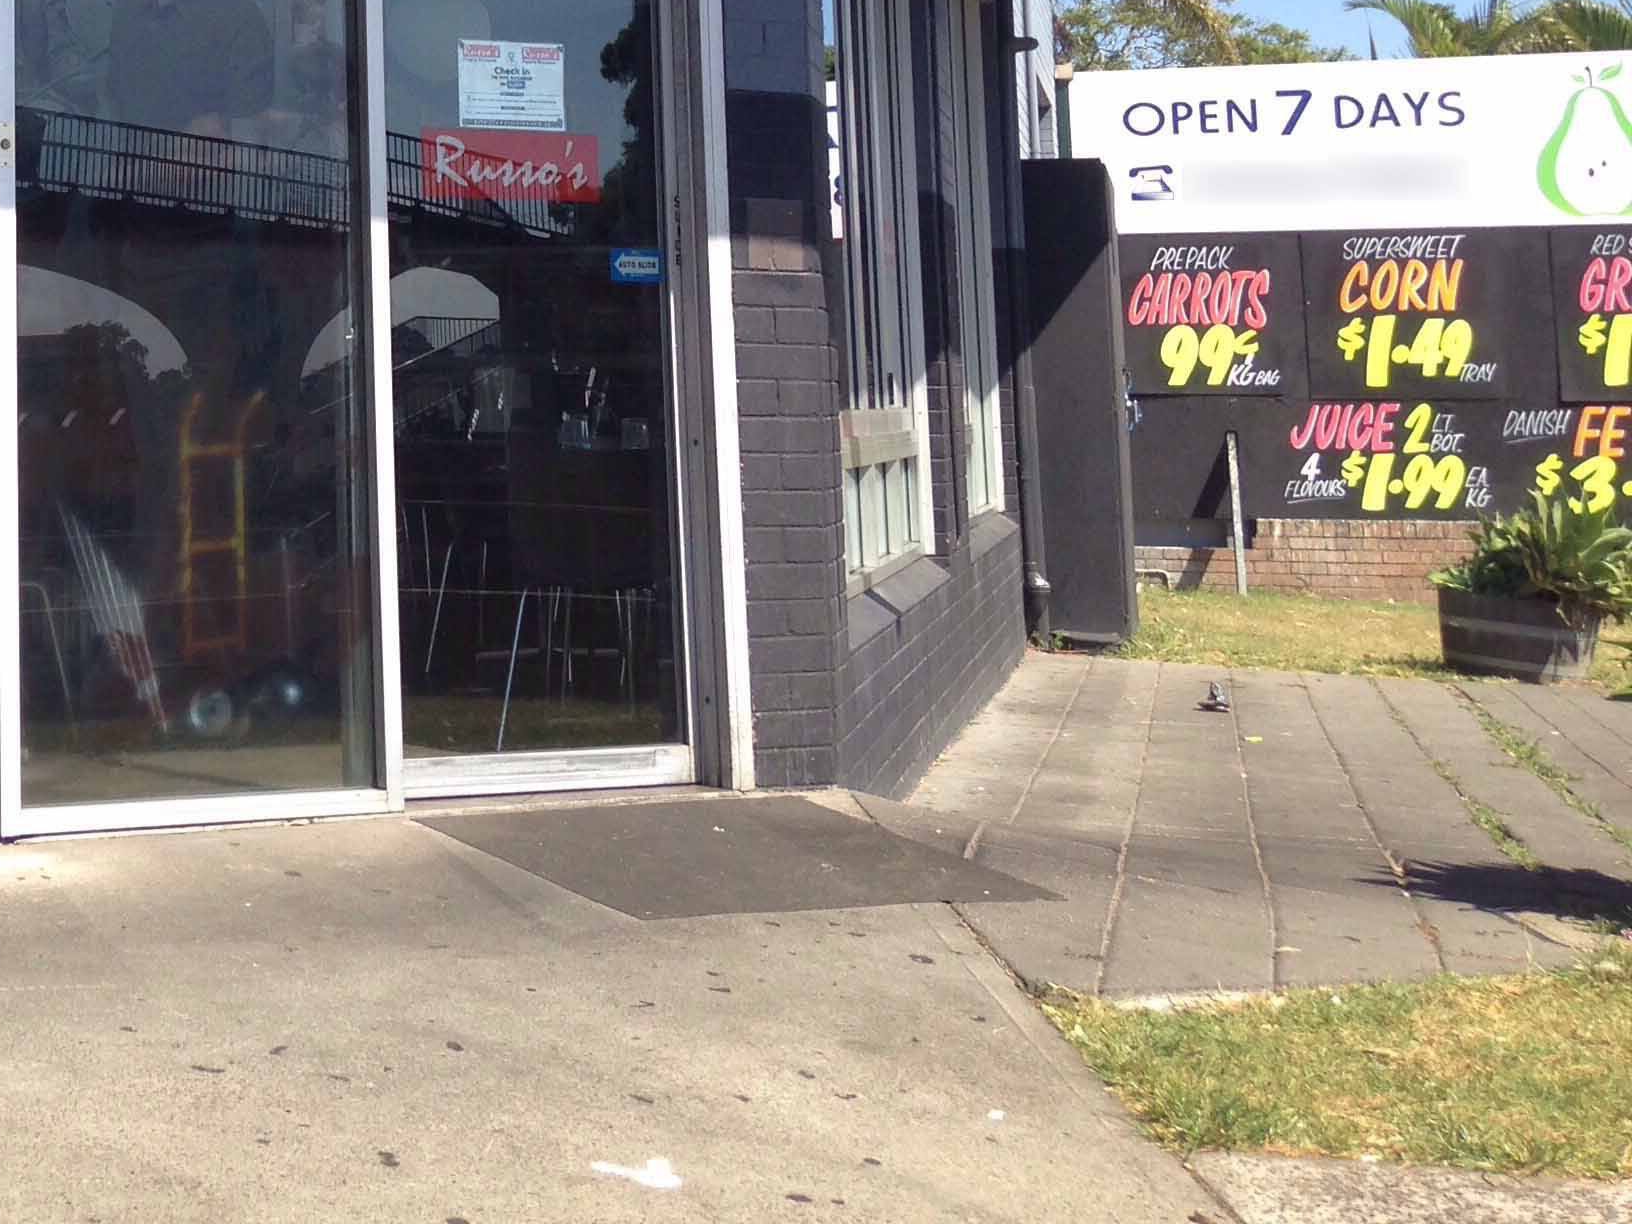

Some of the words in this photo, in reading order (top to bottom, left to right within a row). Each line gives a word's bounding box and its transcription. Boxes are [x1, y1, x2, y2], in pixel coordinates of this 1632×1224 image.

[1122, 98, 1258, 137] OPEN
[1275, 89, 1312, 136] 7
[1334, 91, 1466, 129] DAYS
[434, 135, 588, 190] Russo's
[1150, 246, 1234, 271] PREPACK
[1343, 234, 1466, 260] SUPERSWEET
[1590, 234, 1625, 255] RED
[1128, 268, 1271, 331] CARROTS
[1339, 258, 1465, 314] CORN
[1336, 314, 1473, 388] $1.49
[1254, 369, 1281, 386] BAG
[1458, 362, 1497, 383] TRAY
[1289, 402, 1401, 454] JUICE
[1402, 402, 1432, 453] 2
[1502, 408, 1572, 437] DANISH
[1299, 452, 1321, 482] 4
[1340, 450, 1465, 512] $1.99
[1465, 486, 1493, 509] KG
